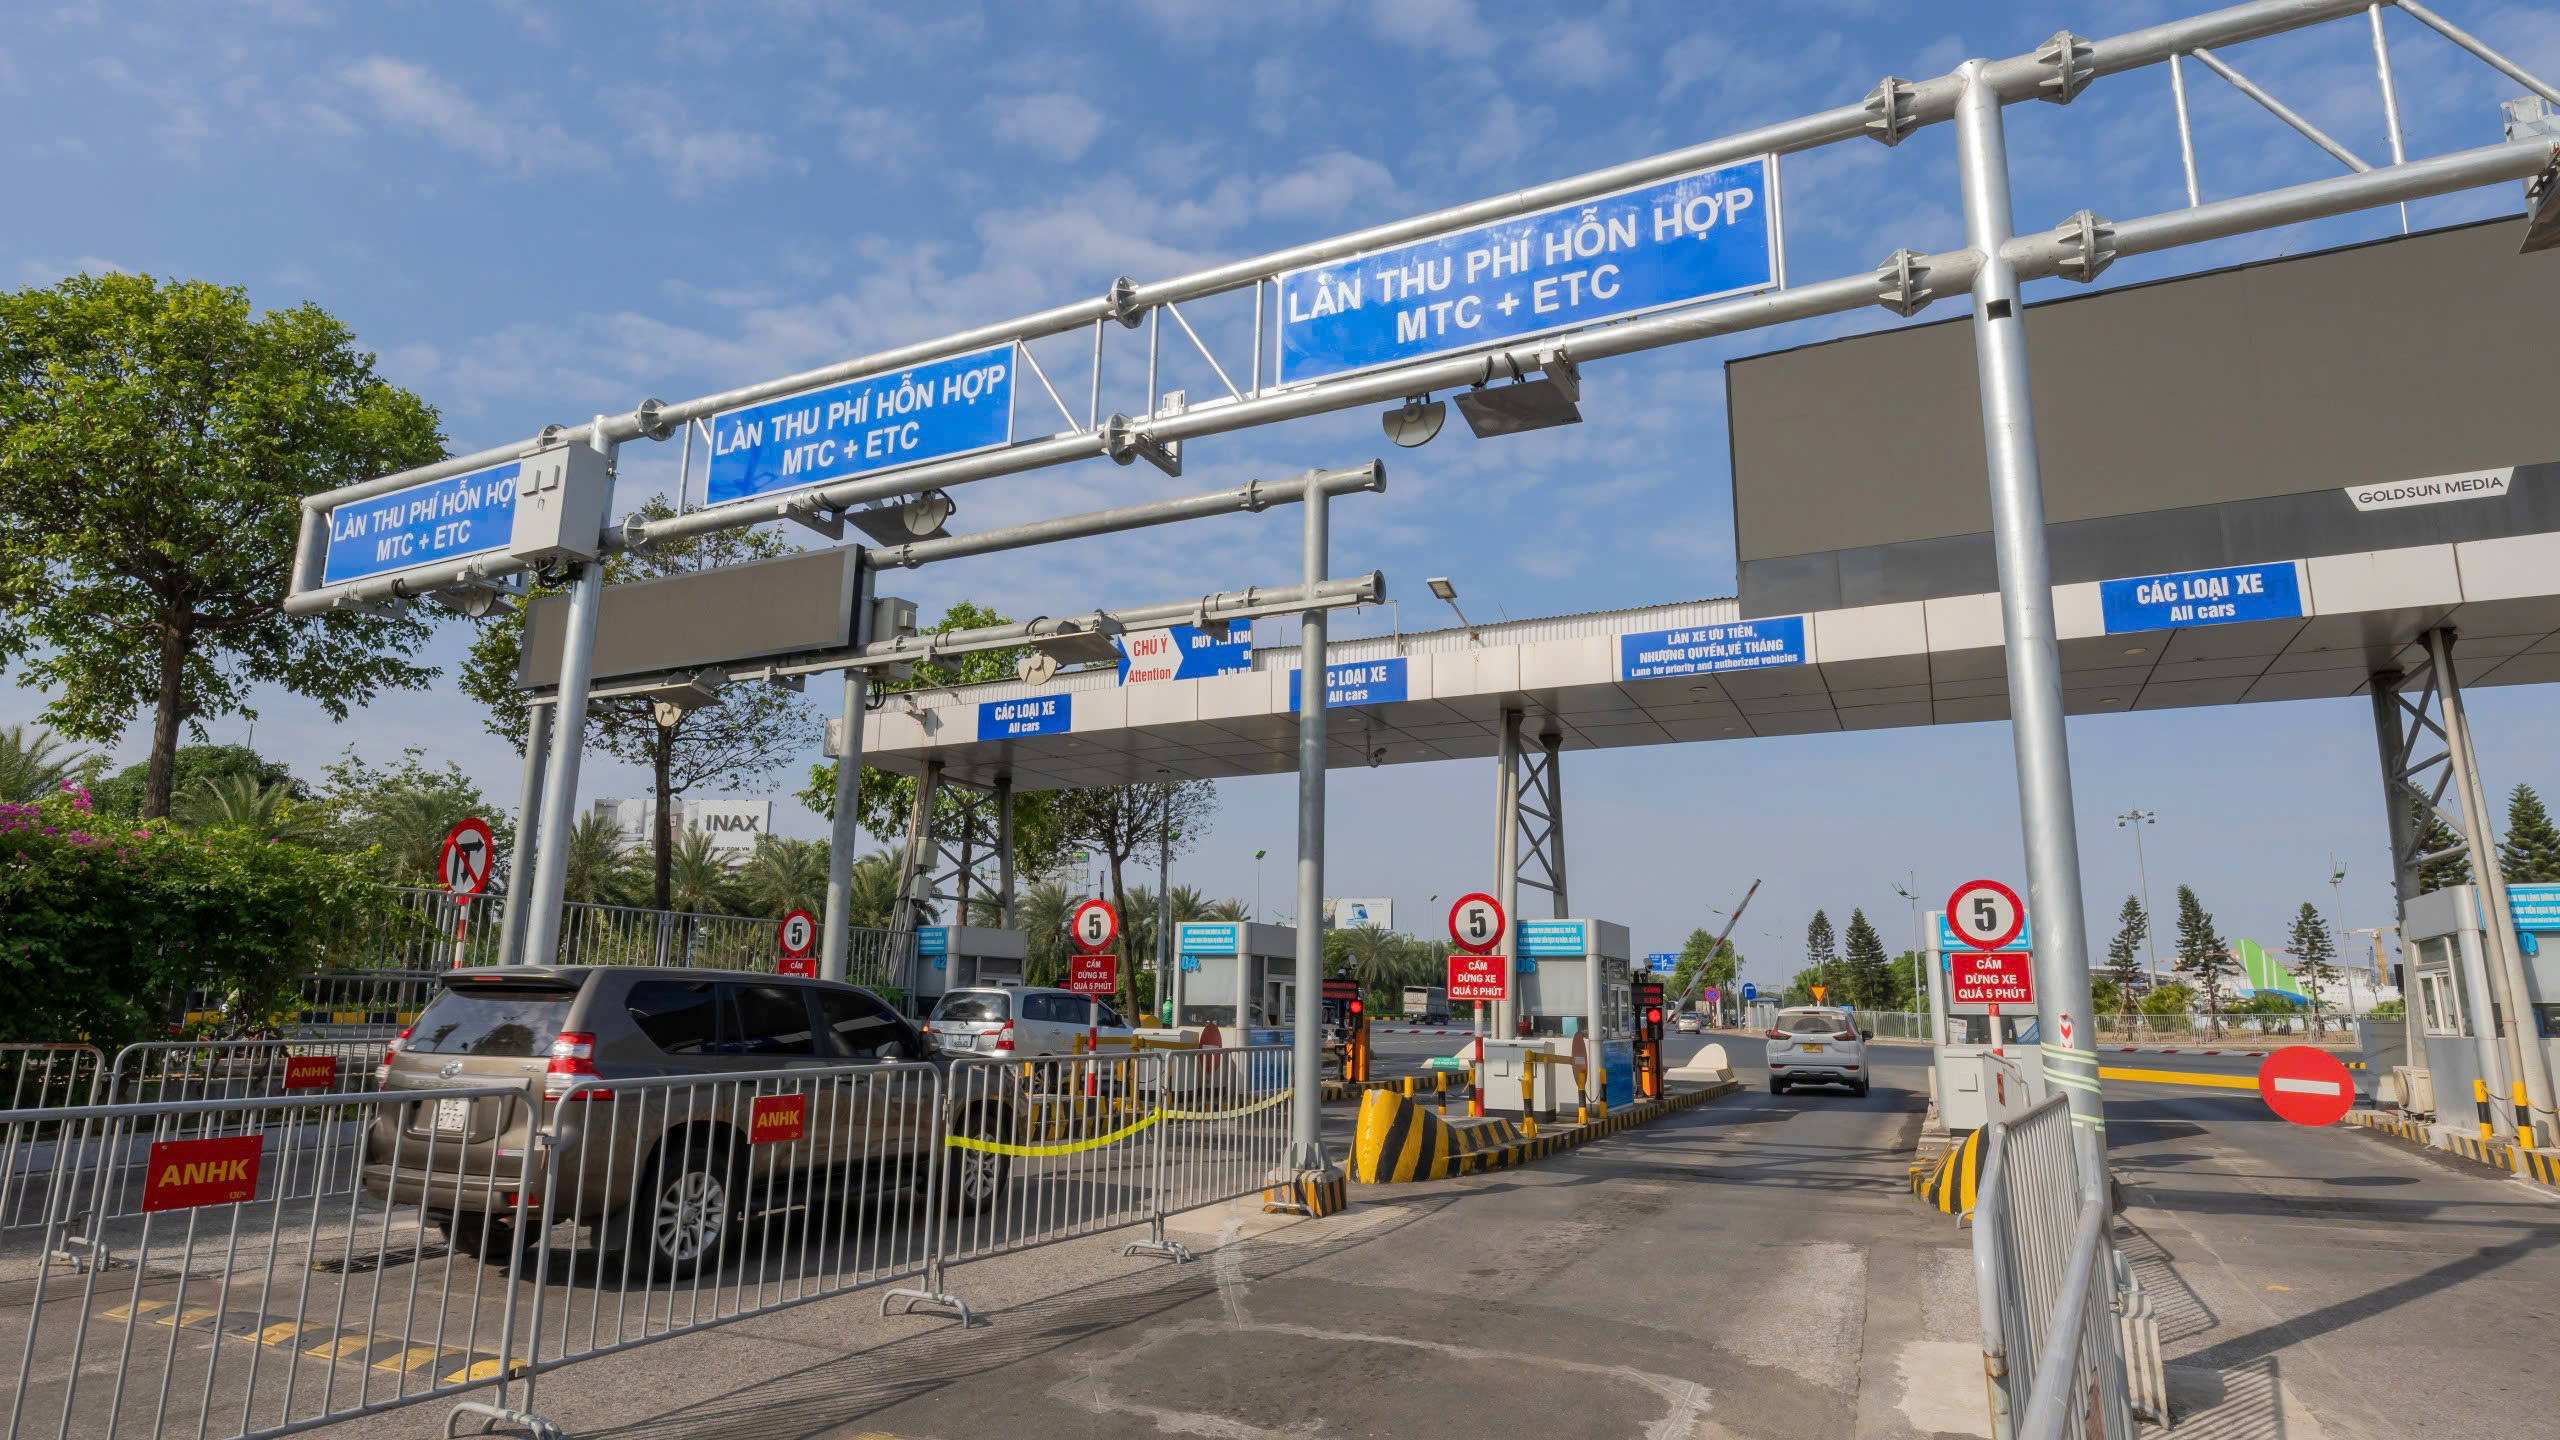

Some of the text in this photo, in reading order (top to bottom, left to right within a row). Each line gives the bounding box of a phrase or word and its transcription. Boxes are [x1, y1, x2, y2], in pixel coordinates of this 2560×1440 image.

[1289, 187, 1754, 324] LÀN THU PHÍ HỖN HỢP
[1396, 264, 1621, 344] MTC + ETC
[716, 365, 1006, 456] LÀN THU PHÍ HỖN HỢP
[782, 421, 920, 476] MTC + ETC
[2358, 476, 2504, 504] GOLDSUN MEDIA
[334, 513, 367, 543] LÀN
[373, 504, 406, 533] THU
[409, 490, 440, 524] PHÍ
[441, 479, 482, 517] HỖN
[376, 520, 472, 562] MTC + ETC
[2136, 573, 2264, 605] CÁC LOẠI XE
[2170, 603, 2236, 622] All cars
[1133, 634, 1168, 657] CHÚ Ý
[1192, 634, 1212, 649] DUY
[1667, 630, 1690, 645] LÀN
[1692, 629, 1707, 643] XE
[1639, 648, 1685, 665] NHƯỢNG
[1744, 639, 1784, 654] THÁNG
[1631, 653, 1798, 677] Lane for priority and authorized vehicles
[1128, 668, 1171, 683] Attention
[1338, 668, 1366, 687] LOẠI
[1370, 665, 1387, 683] XE
[1328, 689, 1368, 703] All cars
[994, 700, 1056, 721] CÁC LOẠI XE
[1008, 721, 1040, 733] All cars
[706, 814, 760, 832] INAX
[1469, 908, 1487, 938] 5
[1974, 898, 1996, 931] 5
[792, 922, 803, 945] 5
[1089, 914, 1101, 939] 5
[790, 961, 803, 969] CẤM
[1086, 958, 1101, 968] CẤM
[1468, 959, 1487, 971] CẤM
[1516, 957, 1537, 973] 06
[1976, 957, 2002, 970] CẤM
[1077, 970, 1108, 980] DỪNG XE
[1457, 973, 1497, 983] DỪNG XE
[1965, 971, 2018, 985] DỪNG XE
[1073, 980, 1088, 991] QUÁ
[1088, 982, 1094, 990] 5
[1094, 980, 1112, 991] PHÚT
[1452, 985, 1503, 996] QUÁ 5 PHÚT
[1958, 986, 2027, 1000] QUÁ 5 PHÚT
[291, 1066, 331, 1078] ANHK
[756, 1110, 801, 1129] ANHK
[158, 1158, 250, 1188] ANHK
